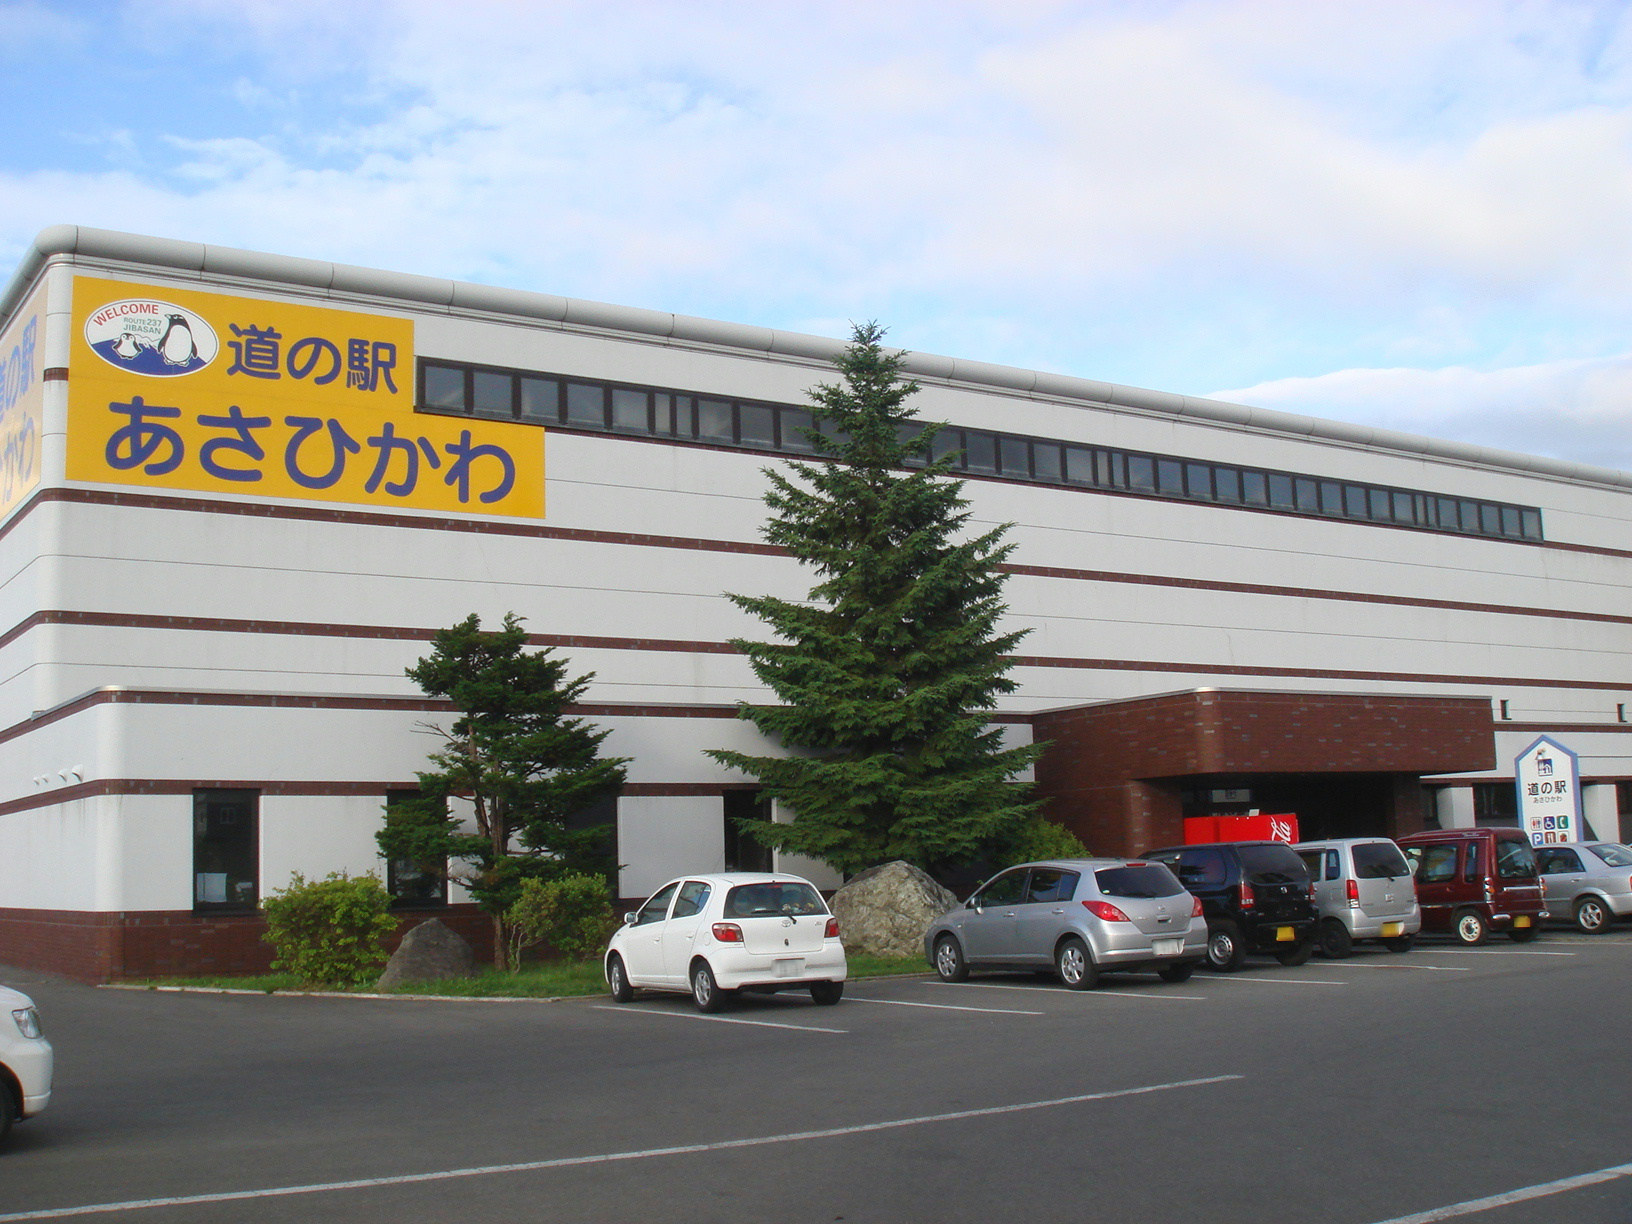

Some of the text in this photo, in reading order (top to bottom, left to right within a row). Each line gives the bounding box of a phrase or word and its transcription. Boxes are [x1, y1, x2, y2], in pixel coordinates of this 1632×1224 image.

[93, 303, 159, 326] WELCOME
[123, 317, 162, 328] ROUTE 237
[123, 324, 162, 335] JIBASAN
[227, 323, 399, 395] 道の駅
[106, 396, 515, 503] あさひかわ
[1527, 781, 1567, 795] 道の駅
